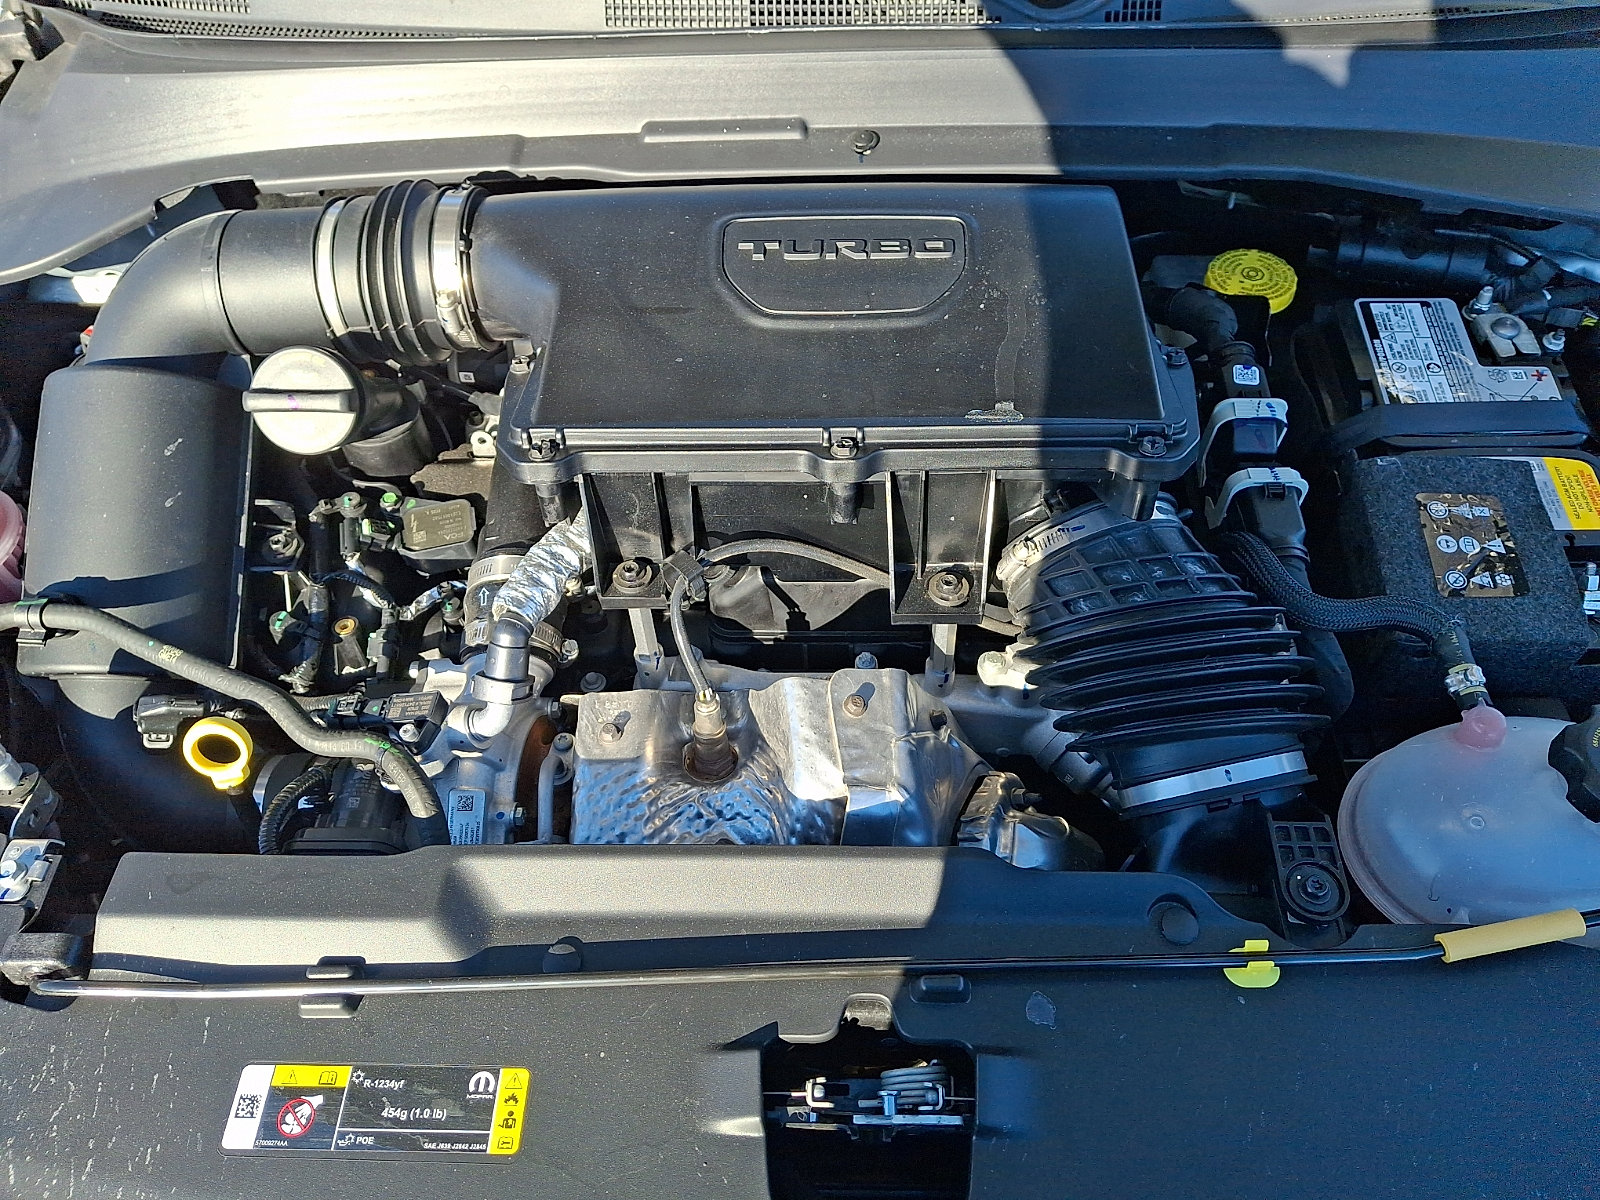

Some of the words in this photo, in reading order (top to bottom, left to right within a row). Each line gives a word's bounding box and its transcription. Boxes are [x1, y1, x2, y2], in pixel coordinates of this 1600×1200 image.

[737, 238, 956, 261] TURBO
[363, 1078, 405, 1091] R-1234yf
[381, 1108, 407, 1121] 454g
[410, 1107, 431, 1120] (1.0
[433, 1108, 447, 1121] lb)
[356, 1136, 375, 1145] POE
